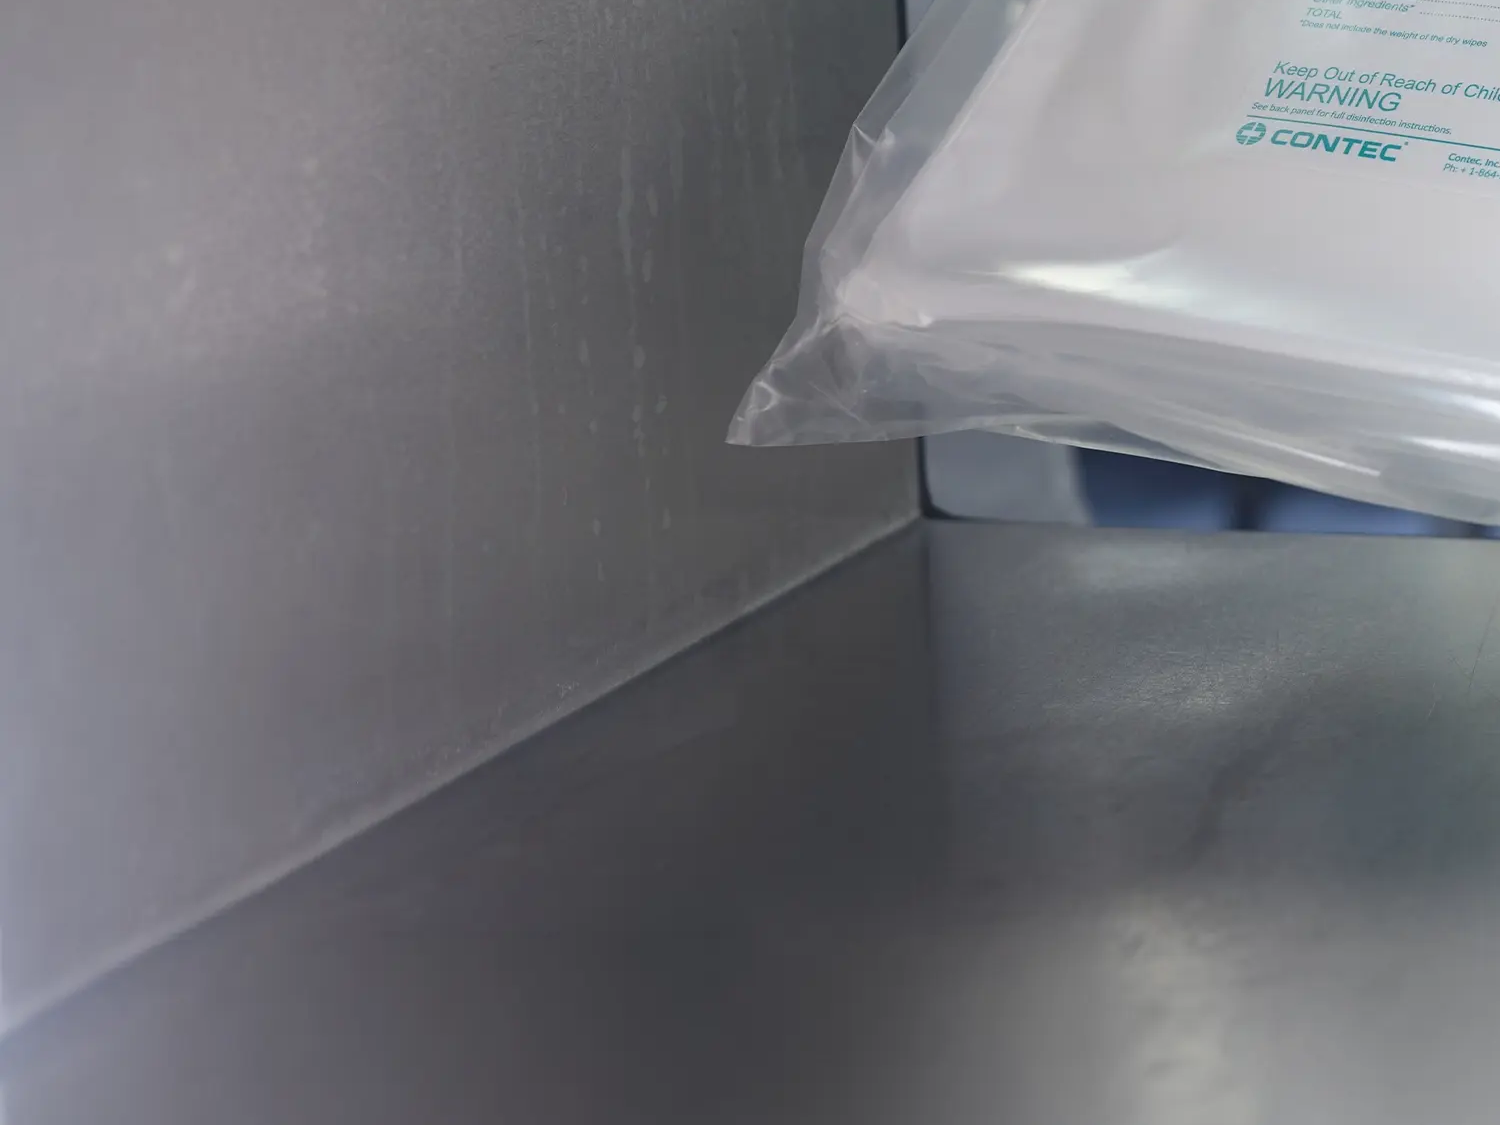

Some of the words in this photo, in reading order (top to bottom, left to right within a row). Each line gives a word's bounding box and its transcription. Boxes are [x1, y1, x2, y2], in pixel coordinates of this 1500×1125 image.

[1306, 7, 1342, 19] TOTAL
[1341, 23, 1371, 33] include
[1373, 26, 1387, 36] the
[1389, 29, 1418, 40] weight
[1431, 34, 1444, 42] the
[1446, 36, 1459, 44] dry
[1462, 39, 1487, 48] wipes
[1273, 60, 1318, 81] Keep
[1324, 66, 1356, 82] Out
[1359, 71, 1377, 84] of
[1380, 73, 1436, 93] Reach
[1441, 82, 1461, 95] of
[1264, 77, 1402, 112] WARNING
[1252, 102, 1268, 111] See
[1270, 104, 1290, 114] back
[1291, 107, 1314, 117] panel
[1316, 109, 1329, 117] for
[1330, 110, 1345, 120] full
[1347, 113, 1396, 127] disinfection
[1399, 120, 1451, 135] instructions.
[1443, 163, 1458, 173] Ph:
[1485, 159, 1500, 168] Inc.
